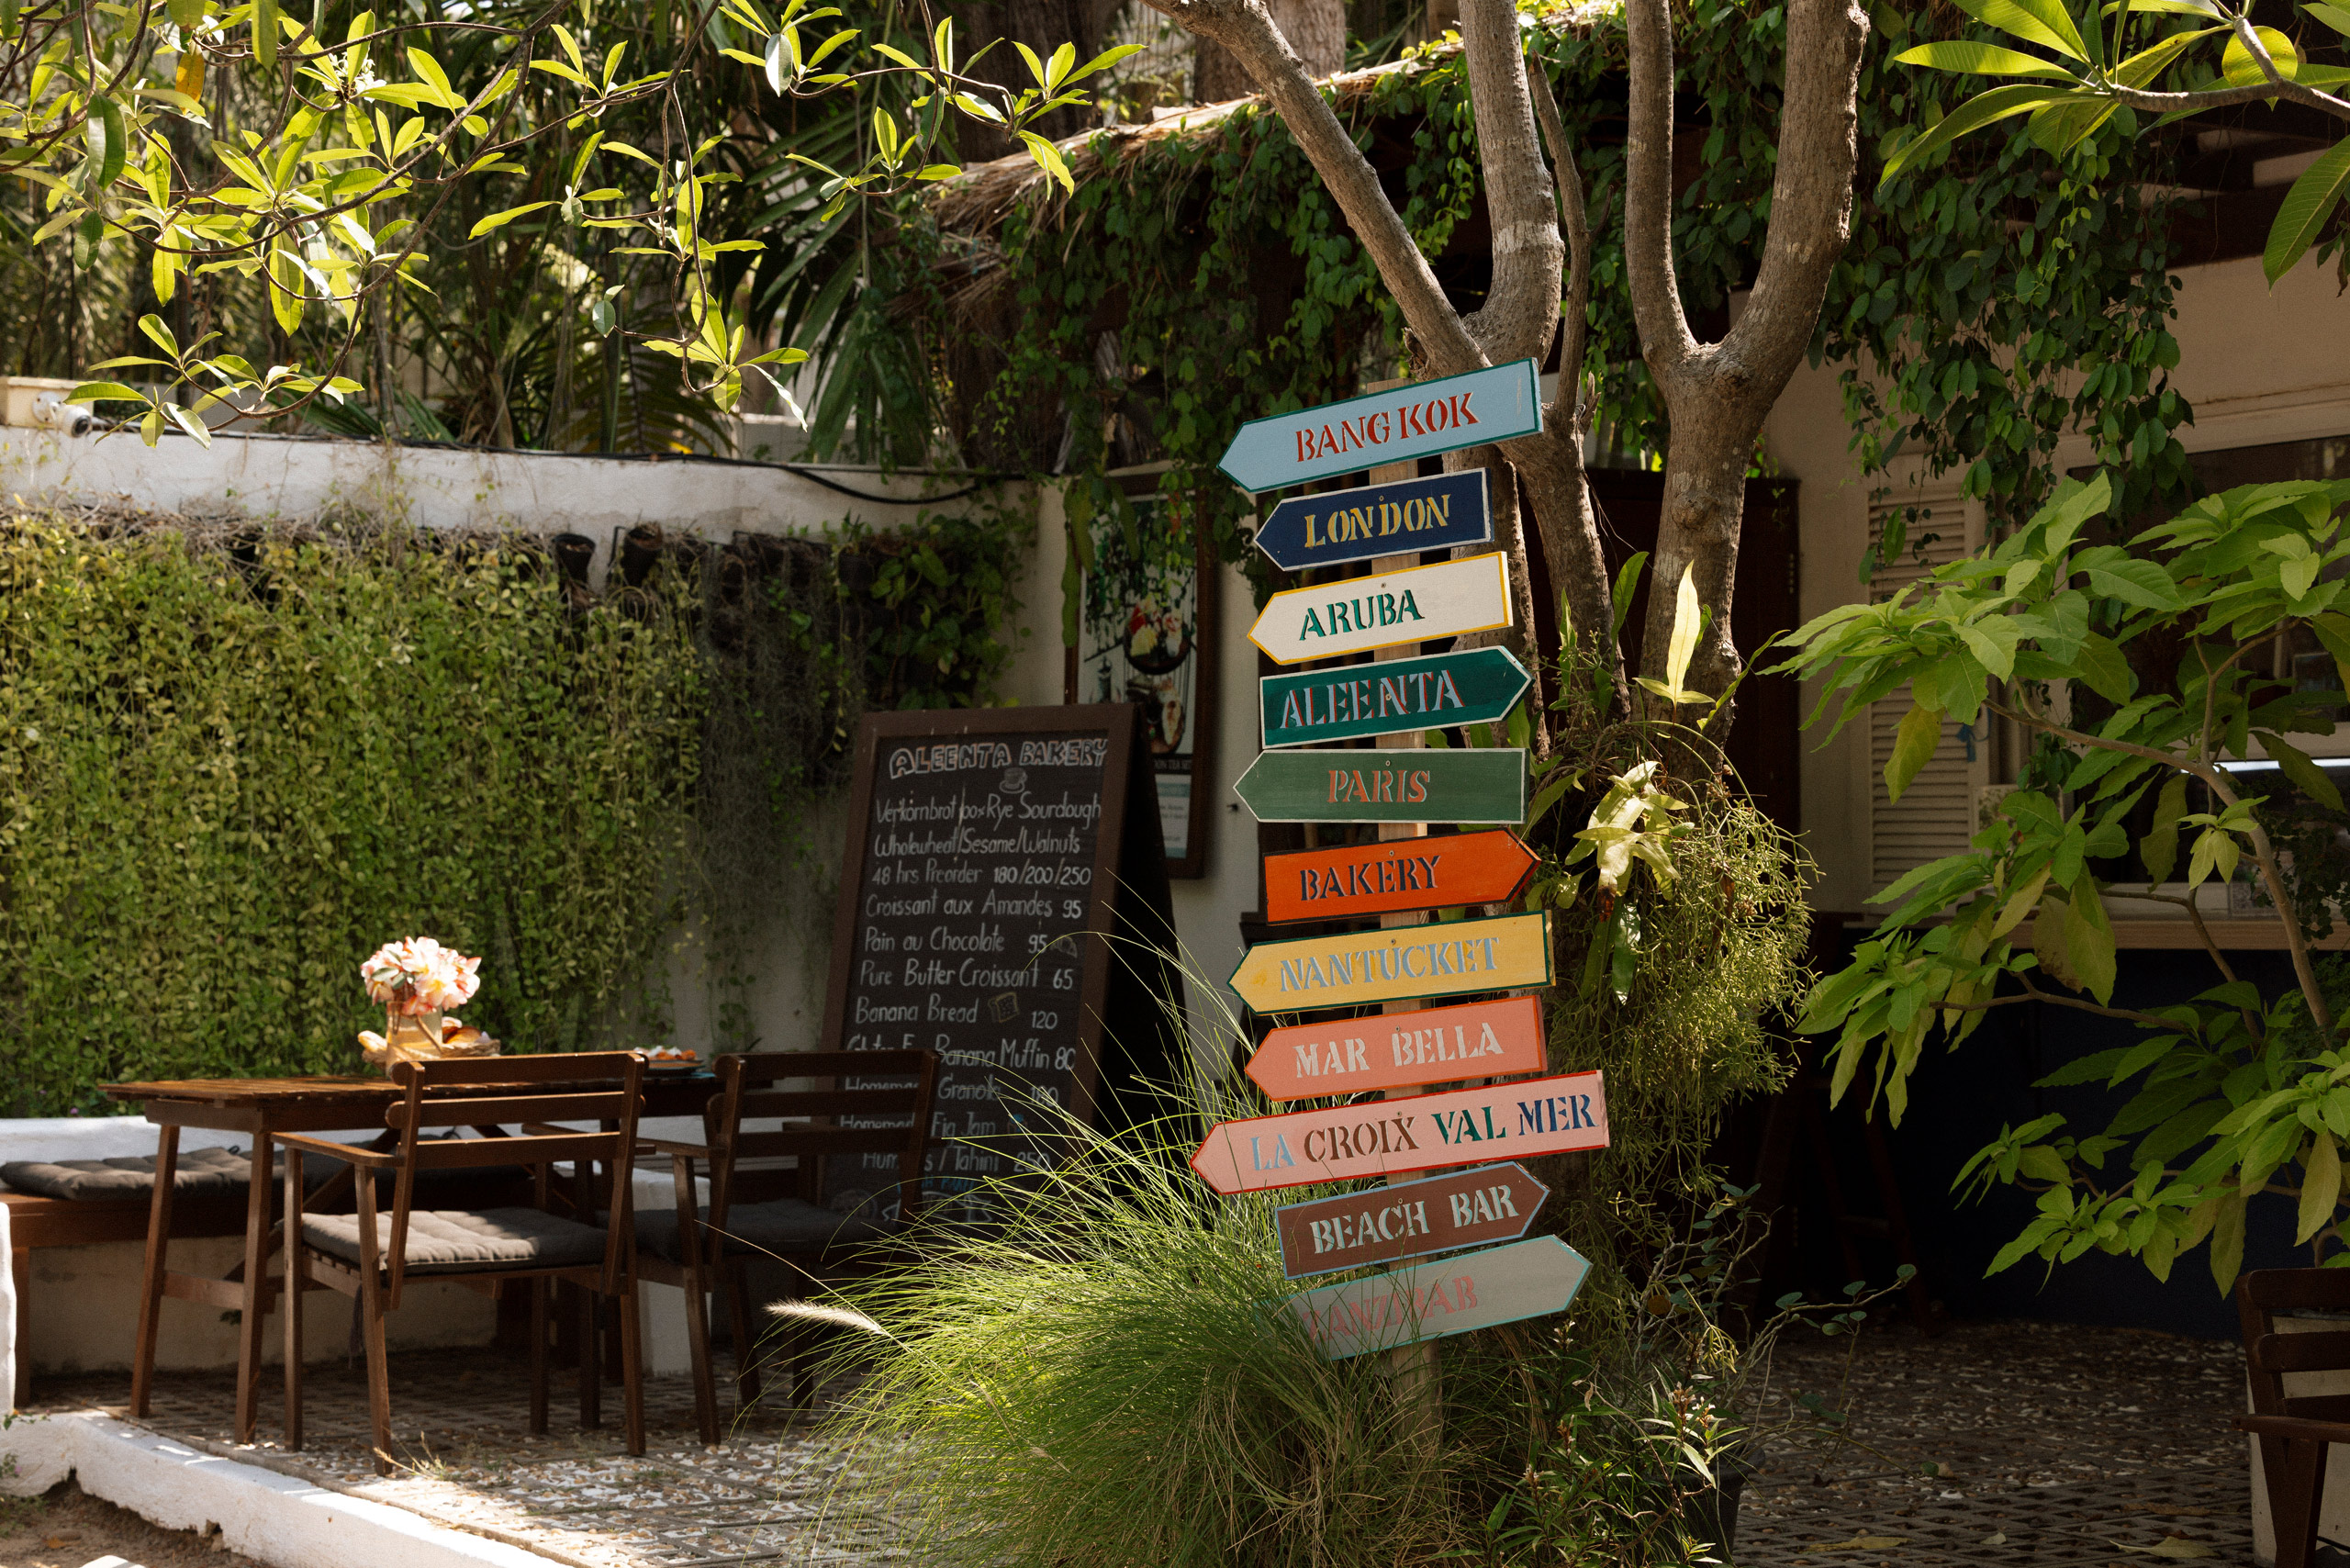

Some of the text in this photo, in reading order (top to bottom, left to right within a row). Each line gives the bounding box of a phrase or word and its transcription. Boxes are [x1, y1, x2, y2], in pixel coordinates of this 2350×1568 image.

[1295, 392, 1481, 463] BANGKOK
[1304, 493, 1451, 548] LONDON
[1299, 589, 1426, 641] ARUBA
[1280, 669, 1465, 729] ALEENTA
[890, 738, 1108, 779] ALEENTA BAKERY
[1326, 769, 1430, 803] PARIS
[1018, 790, 1102, 830] Sourdough
[872, 867, 890, 886] 48
[896, 860, 919, 884] hrs
[925, 858, 982, 885] Preorder
[1300, 855, 1442, 902] BAKERY
[866, 888, 1082, 919] Croissant aux Amandes 95
[865, 923, 1047, 955] Pain au Chocolate 95
[860, 958, 1074, 991] Pure Butter Croissant 65
[1280, 937, 1499, 992] NANTUCKET
[855, 993, 1058, 1030] Banana Bread 120
[1000, 1037, 1050, 1070] Muffin
[1055, 1047, 1077, 1071] 80
[1292, 1022, 1505, 1079] MAR BELLA
[966, 1111, 996, 1137] Jam
[1249, 1093, 1599, 1172] LA CROIX VAL MER
[955, 1145, 1000, 1171] Tahini
[1309, 1184, 1519, 1255] BEACH BAR
